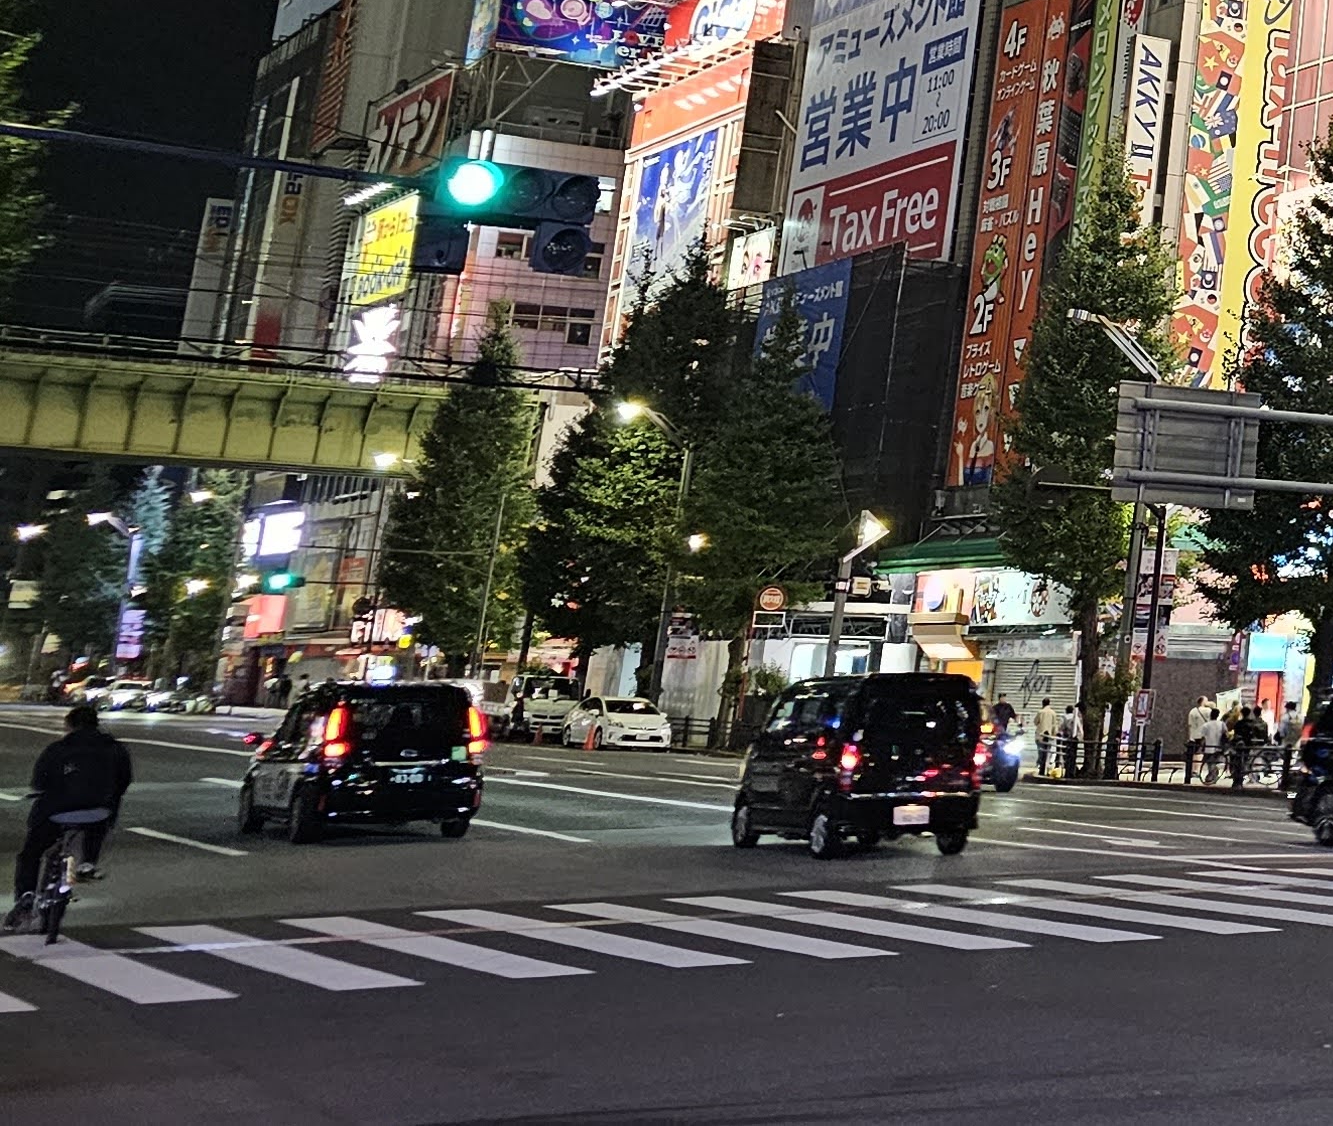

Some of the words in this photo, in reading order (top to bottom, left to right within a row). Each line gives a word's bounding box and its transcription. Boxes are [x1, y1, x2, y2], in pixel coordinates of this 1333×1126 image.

[926, 34, 965, 65] 営業時間
[1003, 19, 1027, 59] 4F
[925, 70, 956, 94] 11:00
[996, 78, 1037, 102] オンラインゲーム
[999, 60, 1037, 84] カードゲーム
[1135, 42, 1163, 141] AKKY
[800, 53, 920, 173] 営業中
[920, 109, 952, 136] 20:00
[1031, 57, 1060, 176] 秋葉原
[987, 151, 1012, 191] 3F
[829, 203, 875, 256] Tax
[877, 186, 941, 243] Free
[1017, 193, 1043, 312] Hey
[970, 294, 995, 334] 2F
[963, 359, 1001, 378] レトロゲーム
[965, 341, 992, 359] プライズ
